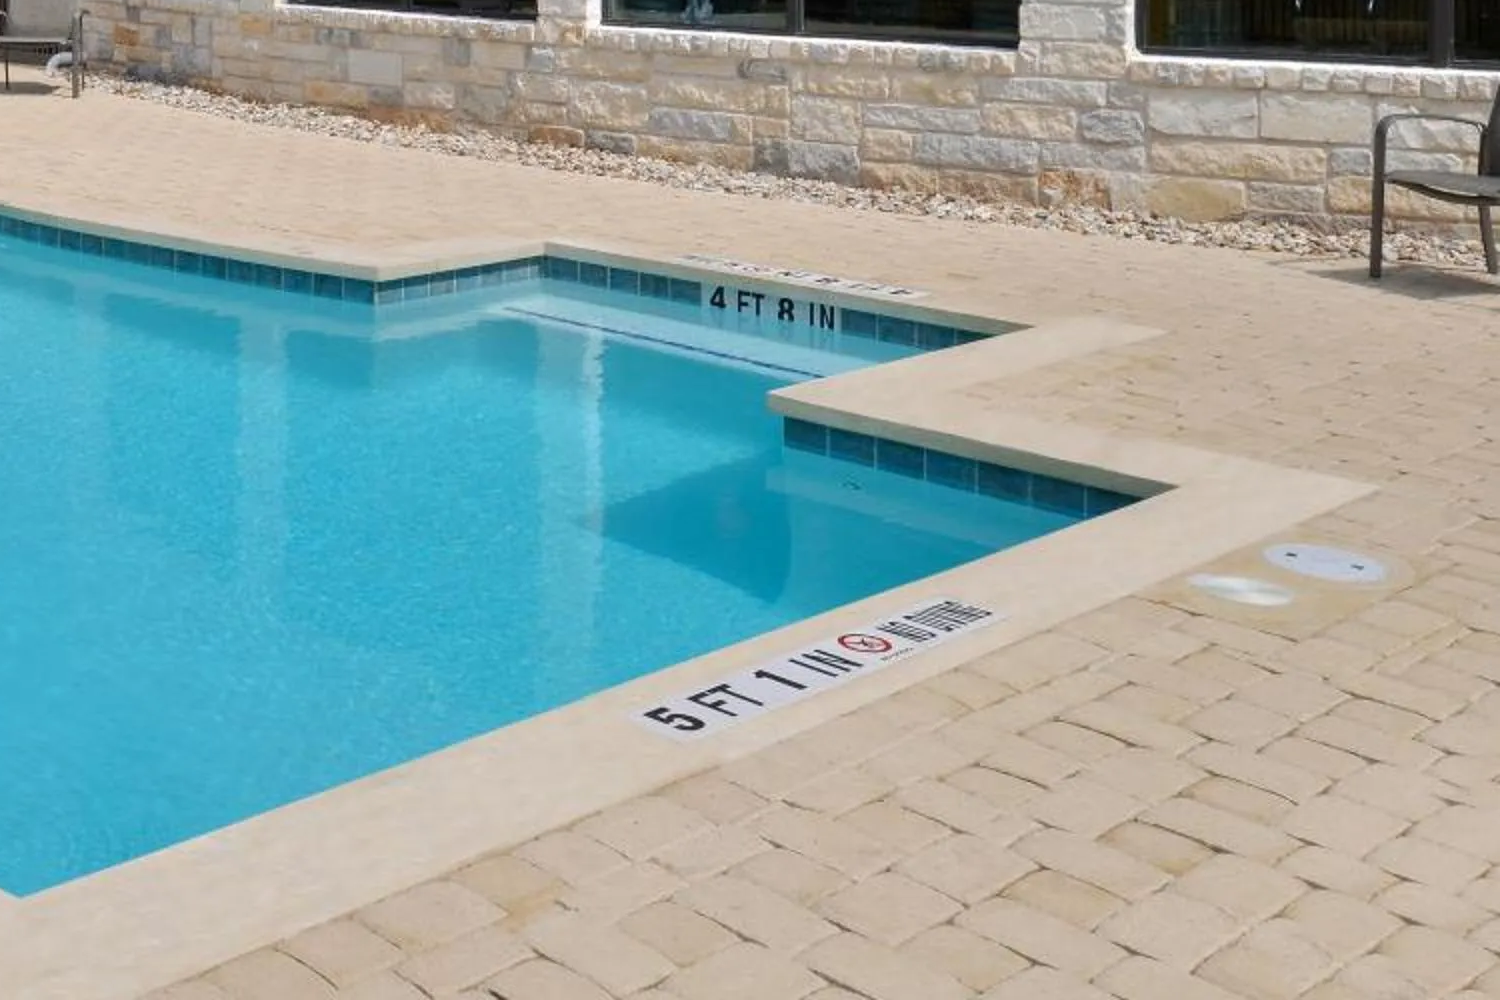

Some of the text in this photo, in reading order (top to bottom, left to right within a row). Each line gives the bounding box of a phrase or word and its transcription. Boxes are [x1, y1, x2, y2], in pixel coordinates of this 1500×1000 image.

[709, 286, 835, 330] 4 FT 8 IN
[643, 706, 706, 732] 5
[687, 684, 763, 717] FT
[753, 669, 807, 690] 1
[789, 648, 864, 678] IN
